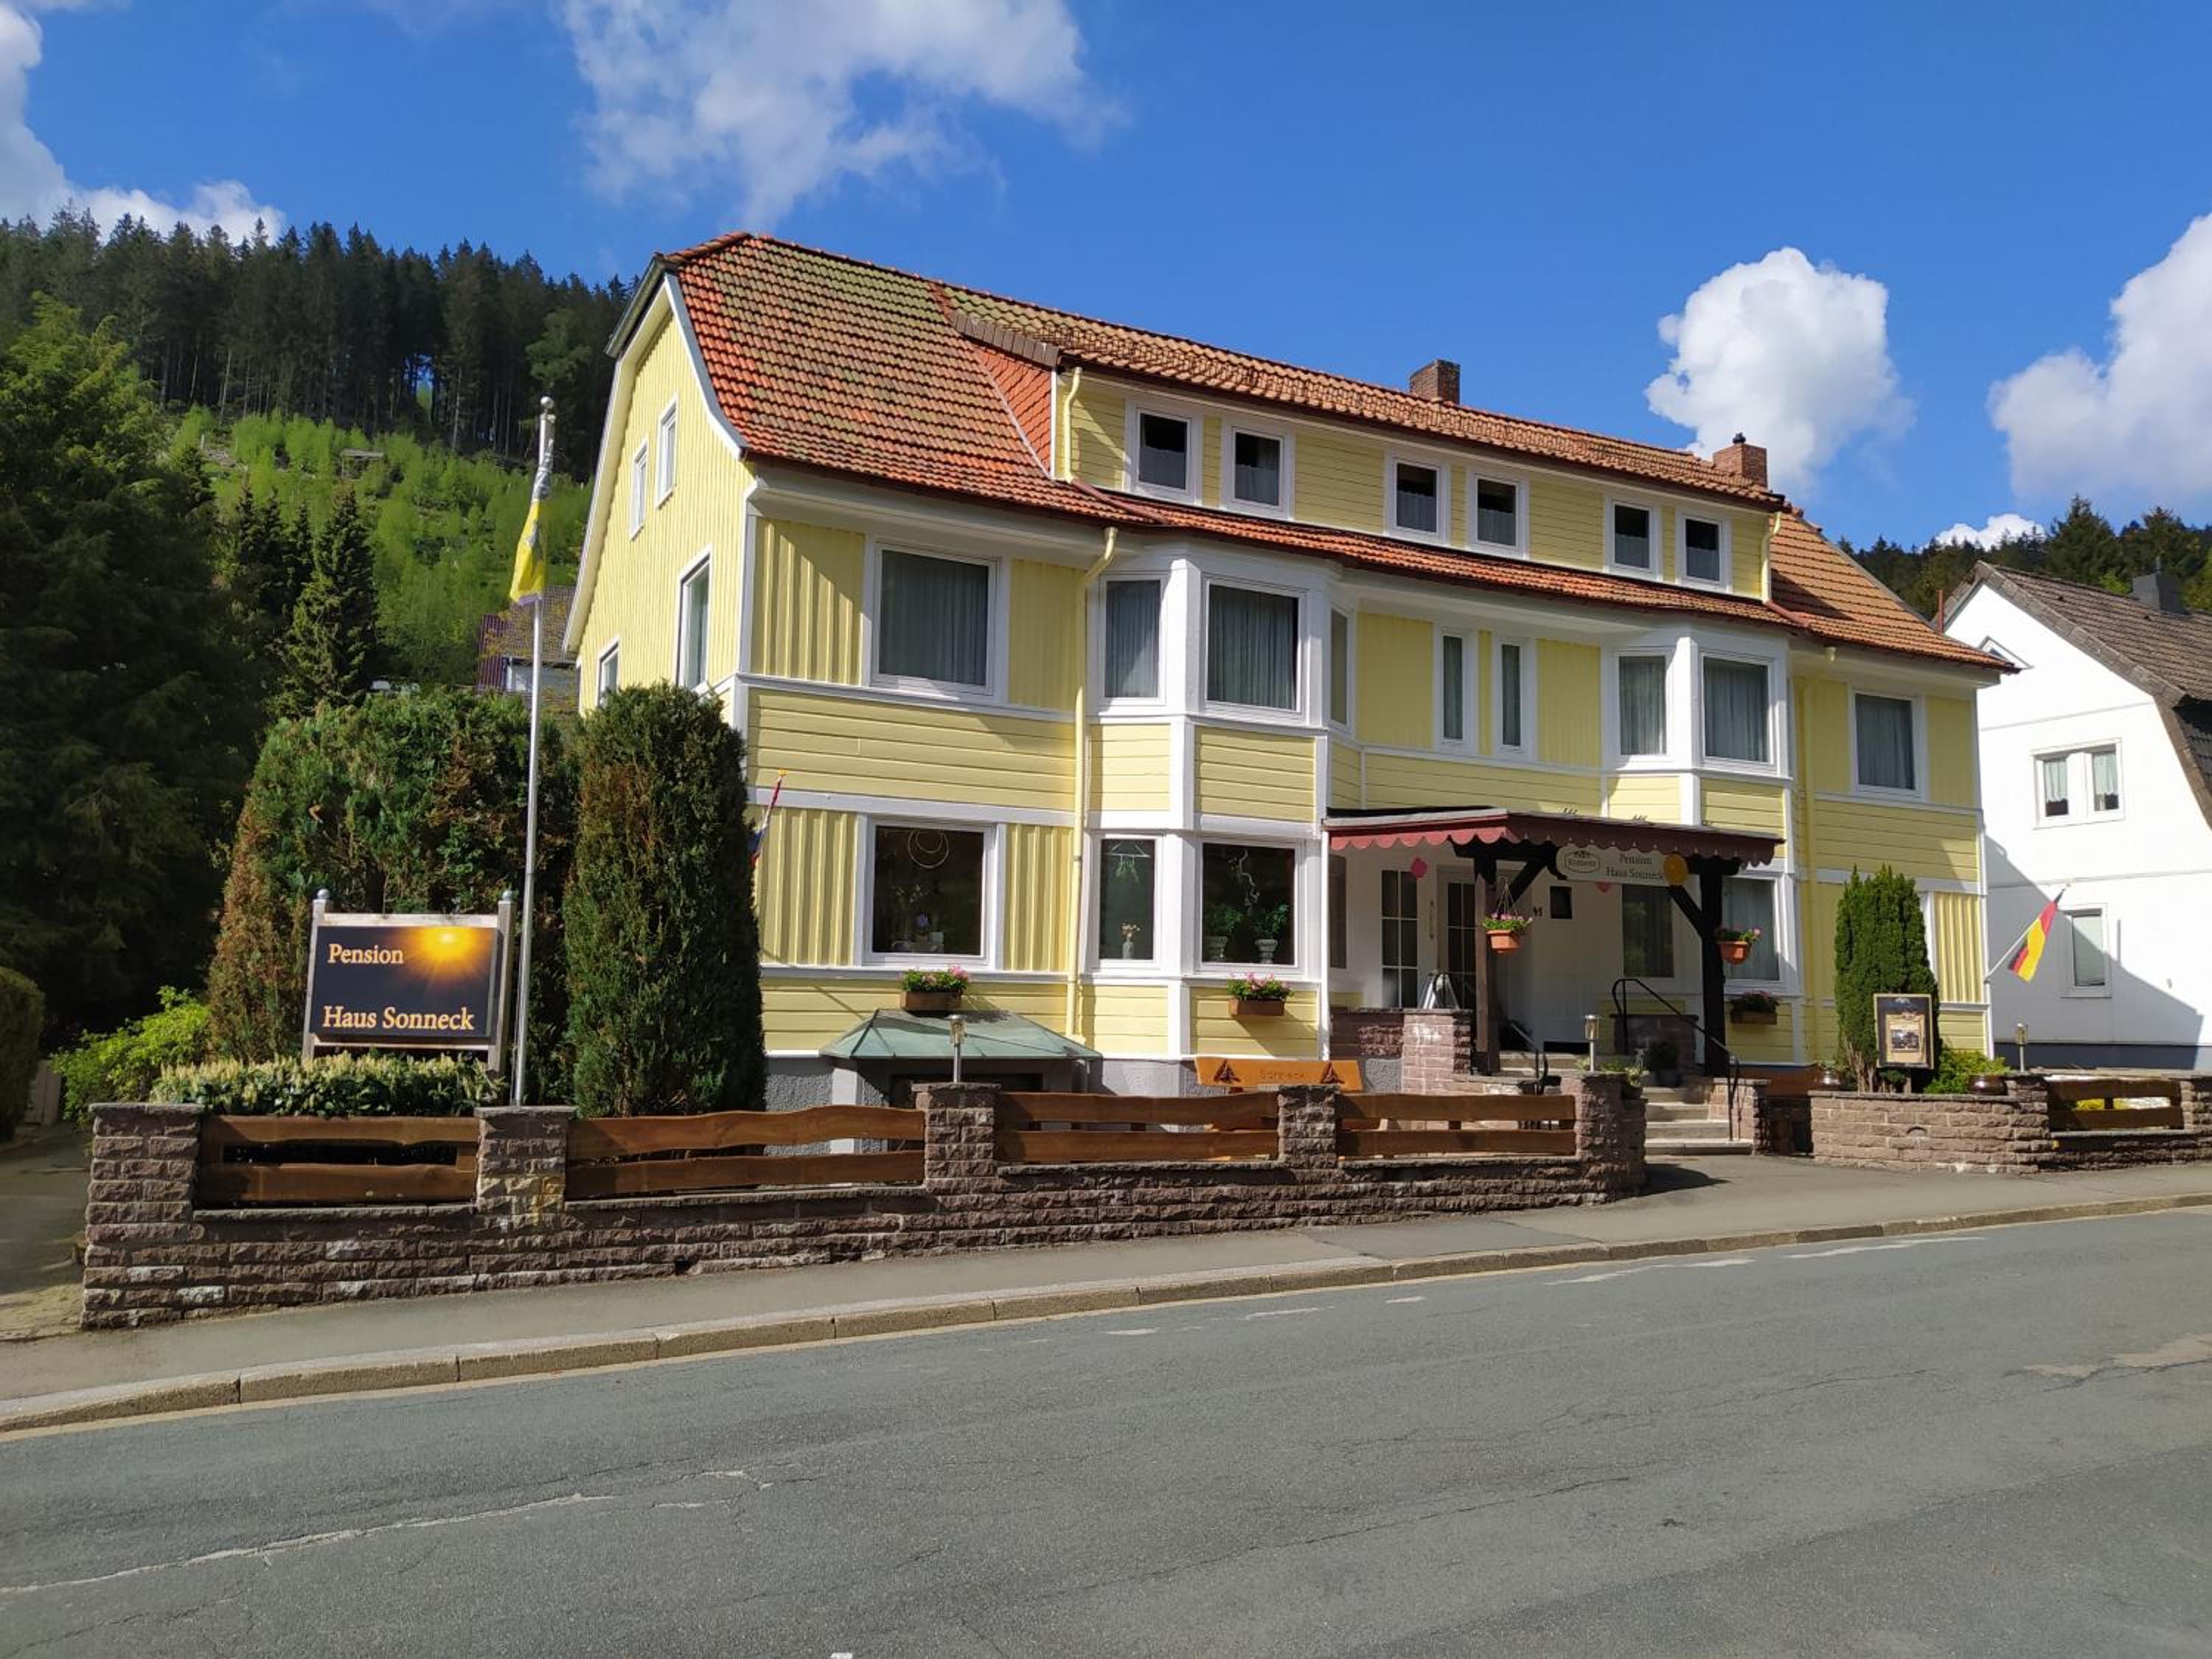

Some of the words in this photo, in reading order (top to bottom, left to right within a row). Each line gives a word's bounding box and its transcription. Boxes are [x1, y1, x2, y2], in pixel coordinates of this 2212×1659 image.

[1619, 854, 1652, 864] Pension
[1605, 866, 1627, 877] Haus
[327, 943, 403, 964] Pension
[322, 1005, 377, 1028] Haus
[382, 1006, 475, 1030] Sonneck
